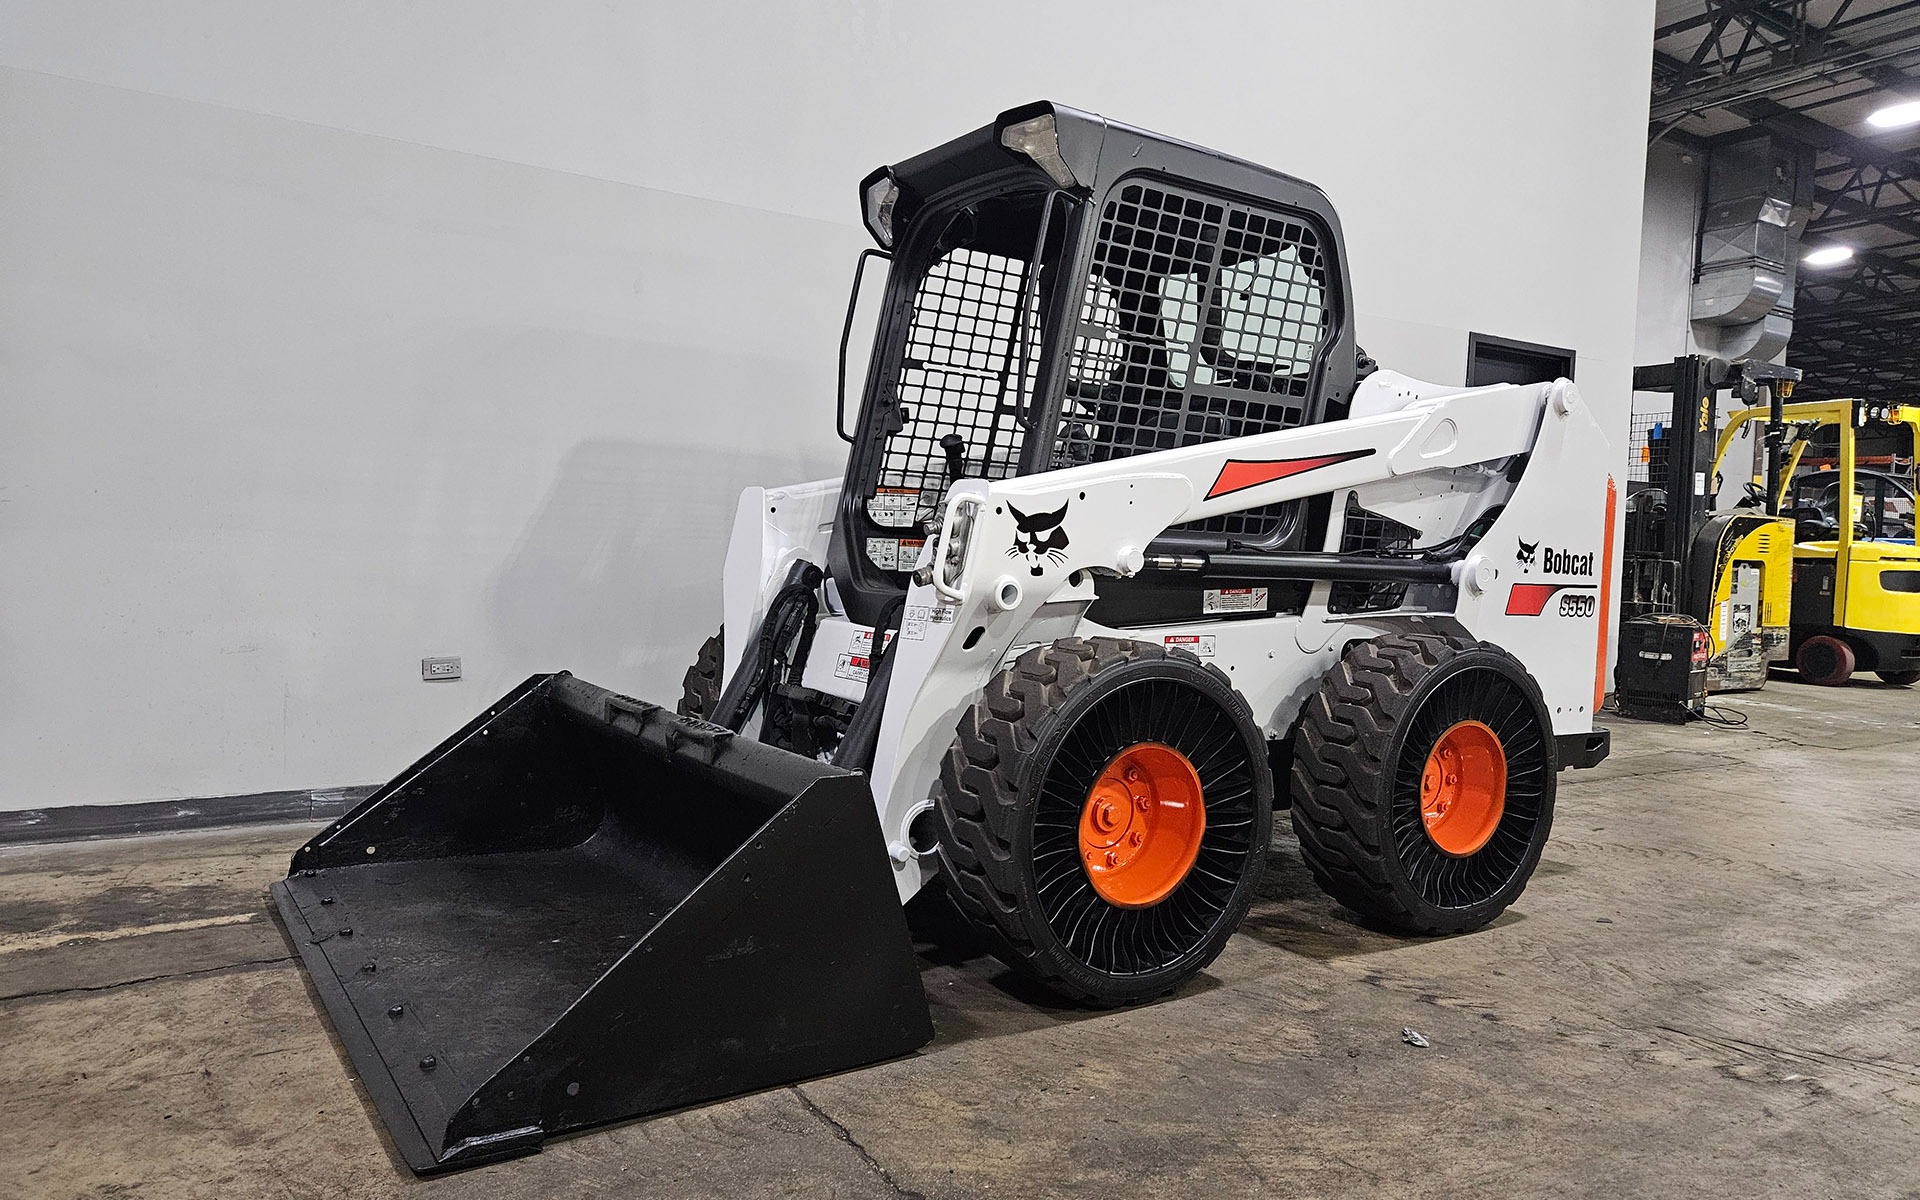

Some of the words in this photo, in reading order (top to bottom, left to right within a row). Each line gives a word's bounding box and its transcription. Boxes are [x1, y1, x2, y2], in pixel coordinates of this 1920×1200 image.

[1699, 396, 1709, 432] Yale
[1543, 547, 1594, 576] Bobcat
[1559, 594, 1596, 617] S550
